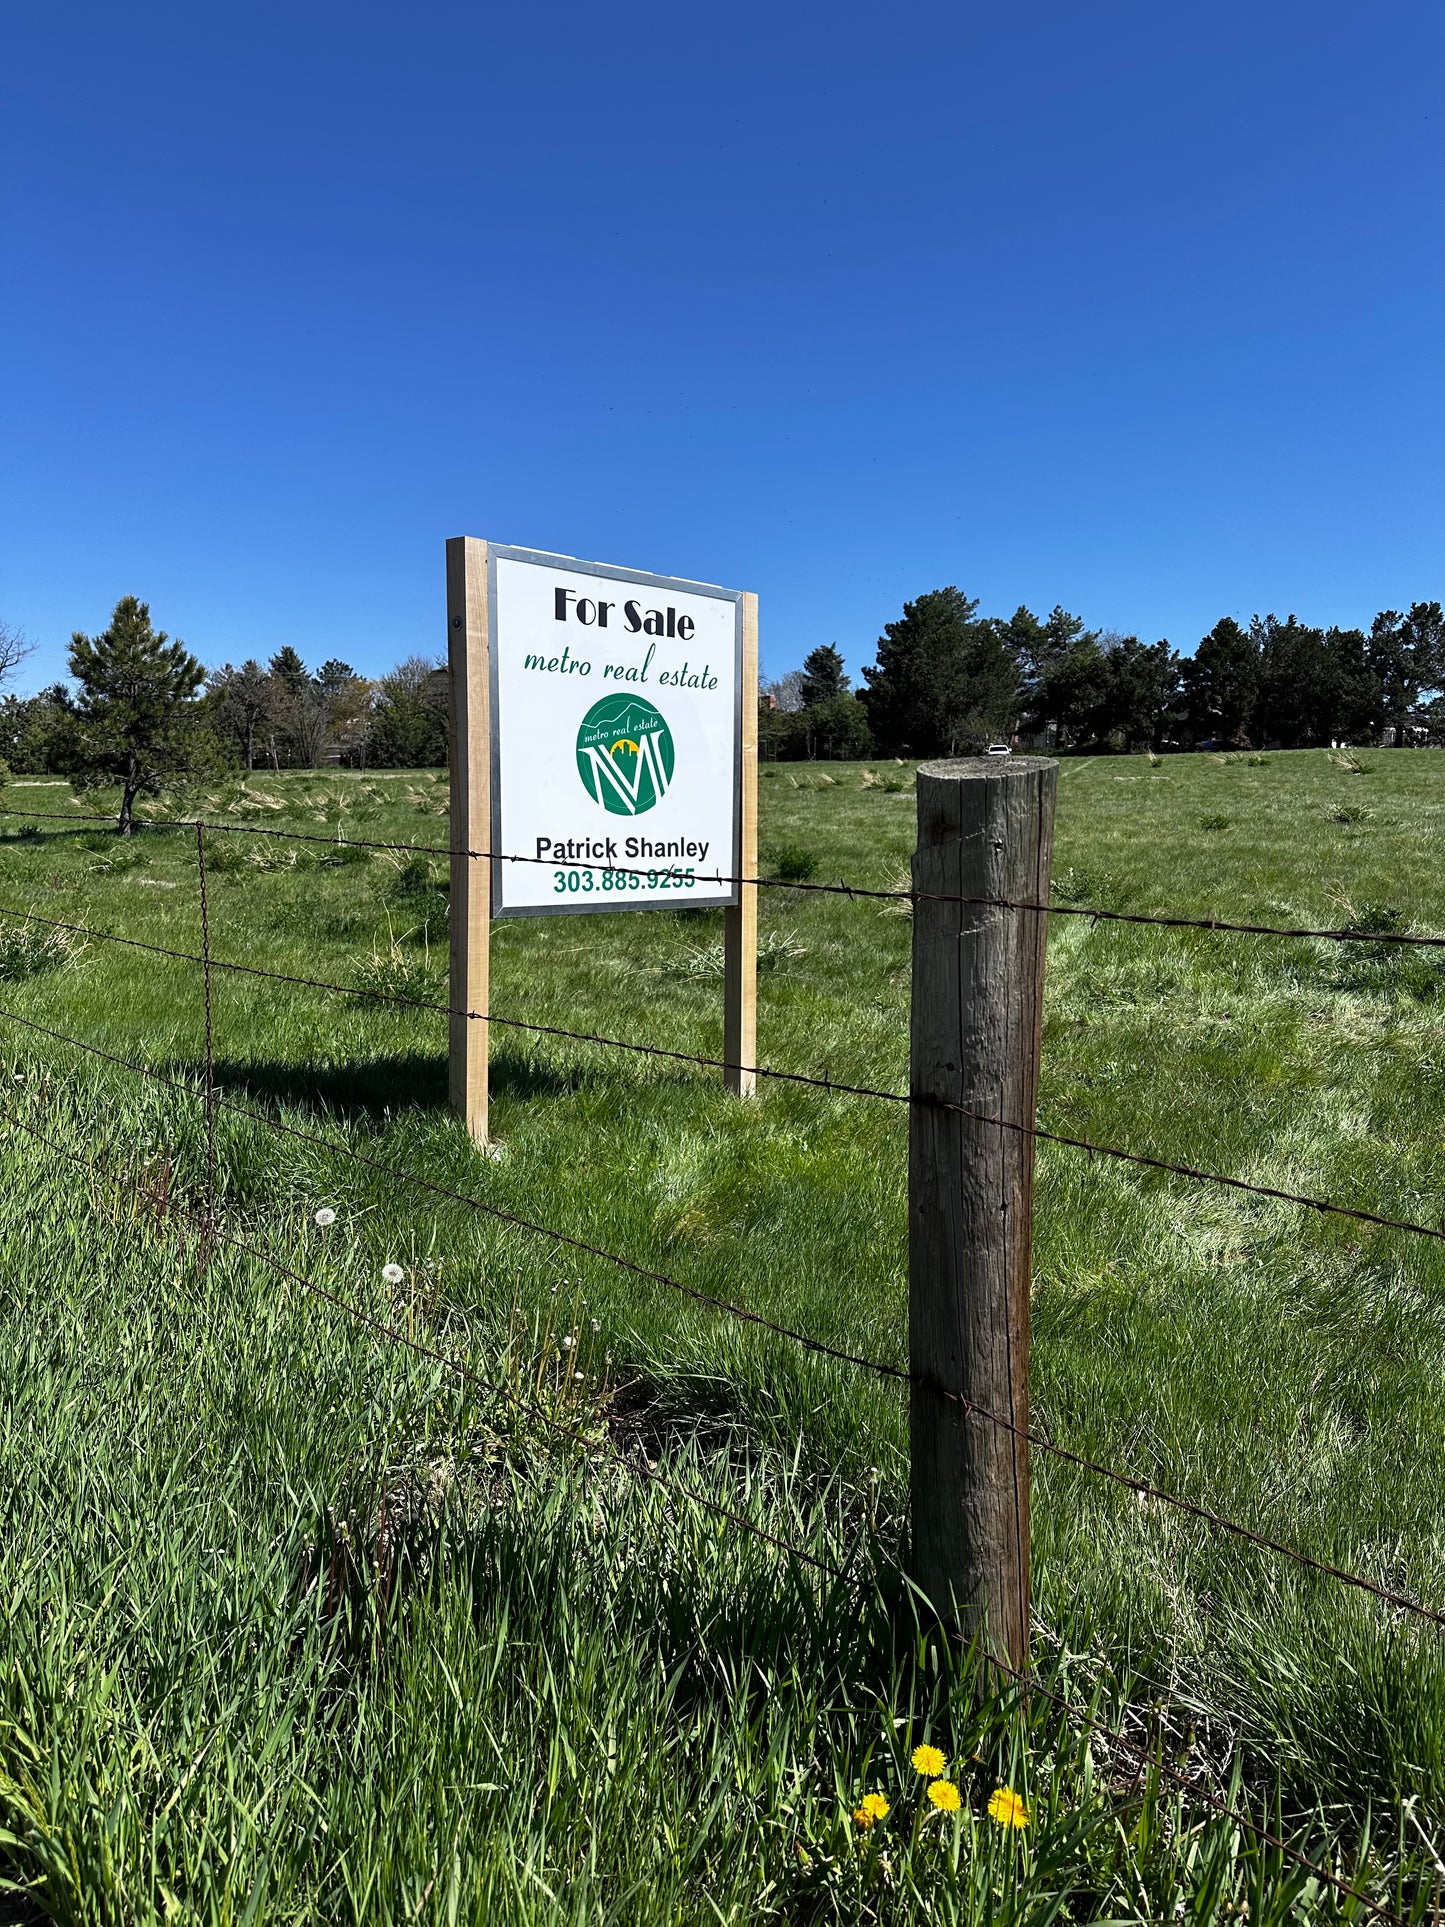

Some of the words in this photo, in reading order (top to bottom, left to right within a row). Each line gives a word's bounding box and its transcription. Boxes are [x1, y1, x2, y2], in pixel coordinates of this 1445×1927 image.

[554, 587, 615, 628] For
[623, 600, 695, 640] Sale
[524, 646, 592, 676] metro
[603, 643, 656, 683] real
[659, 662, 718, 690] estate
[584, 730, 609, 743] metro
[612, 715, 631, 737] real
[633, 716, 658, 732] estate
[536, 837, 618, 859] Patrick
[625, 836, 710, 862] Shanley
[553, 868, 695, 893] 303.885.9255
